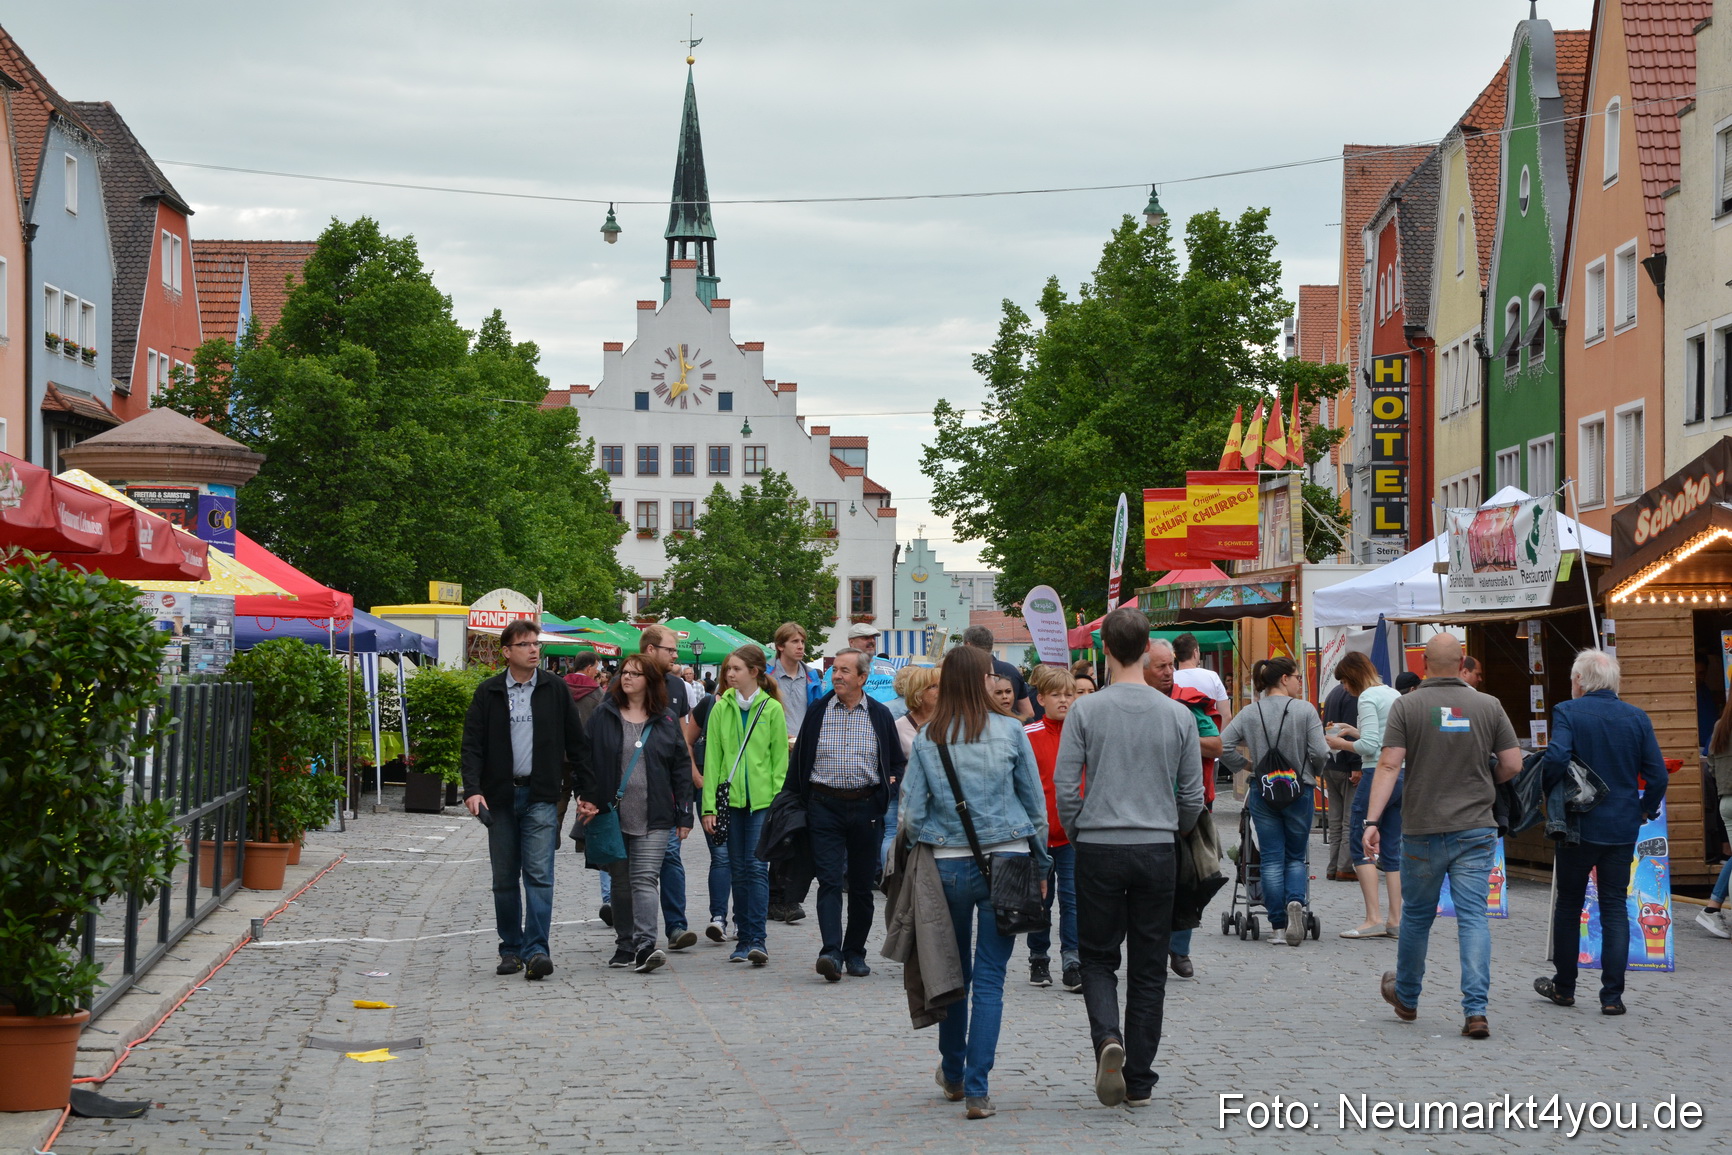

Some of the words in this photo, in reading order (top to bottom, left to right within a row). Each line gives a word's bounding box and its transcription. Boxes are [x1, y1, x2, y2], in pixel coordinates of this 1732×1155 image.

[1372, 359, 1404, 530] HOTEL
[1192, 488, 1254, 524] CHURROS
[1193, 488, 1221, 507] Original
[208, 509, 232, 529] G6
[1634, 473, 1710, 545] Schoko
[1520, 568, 1552, 584] Restaurant
[1525, 592, 1537, 603] Vegan
